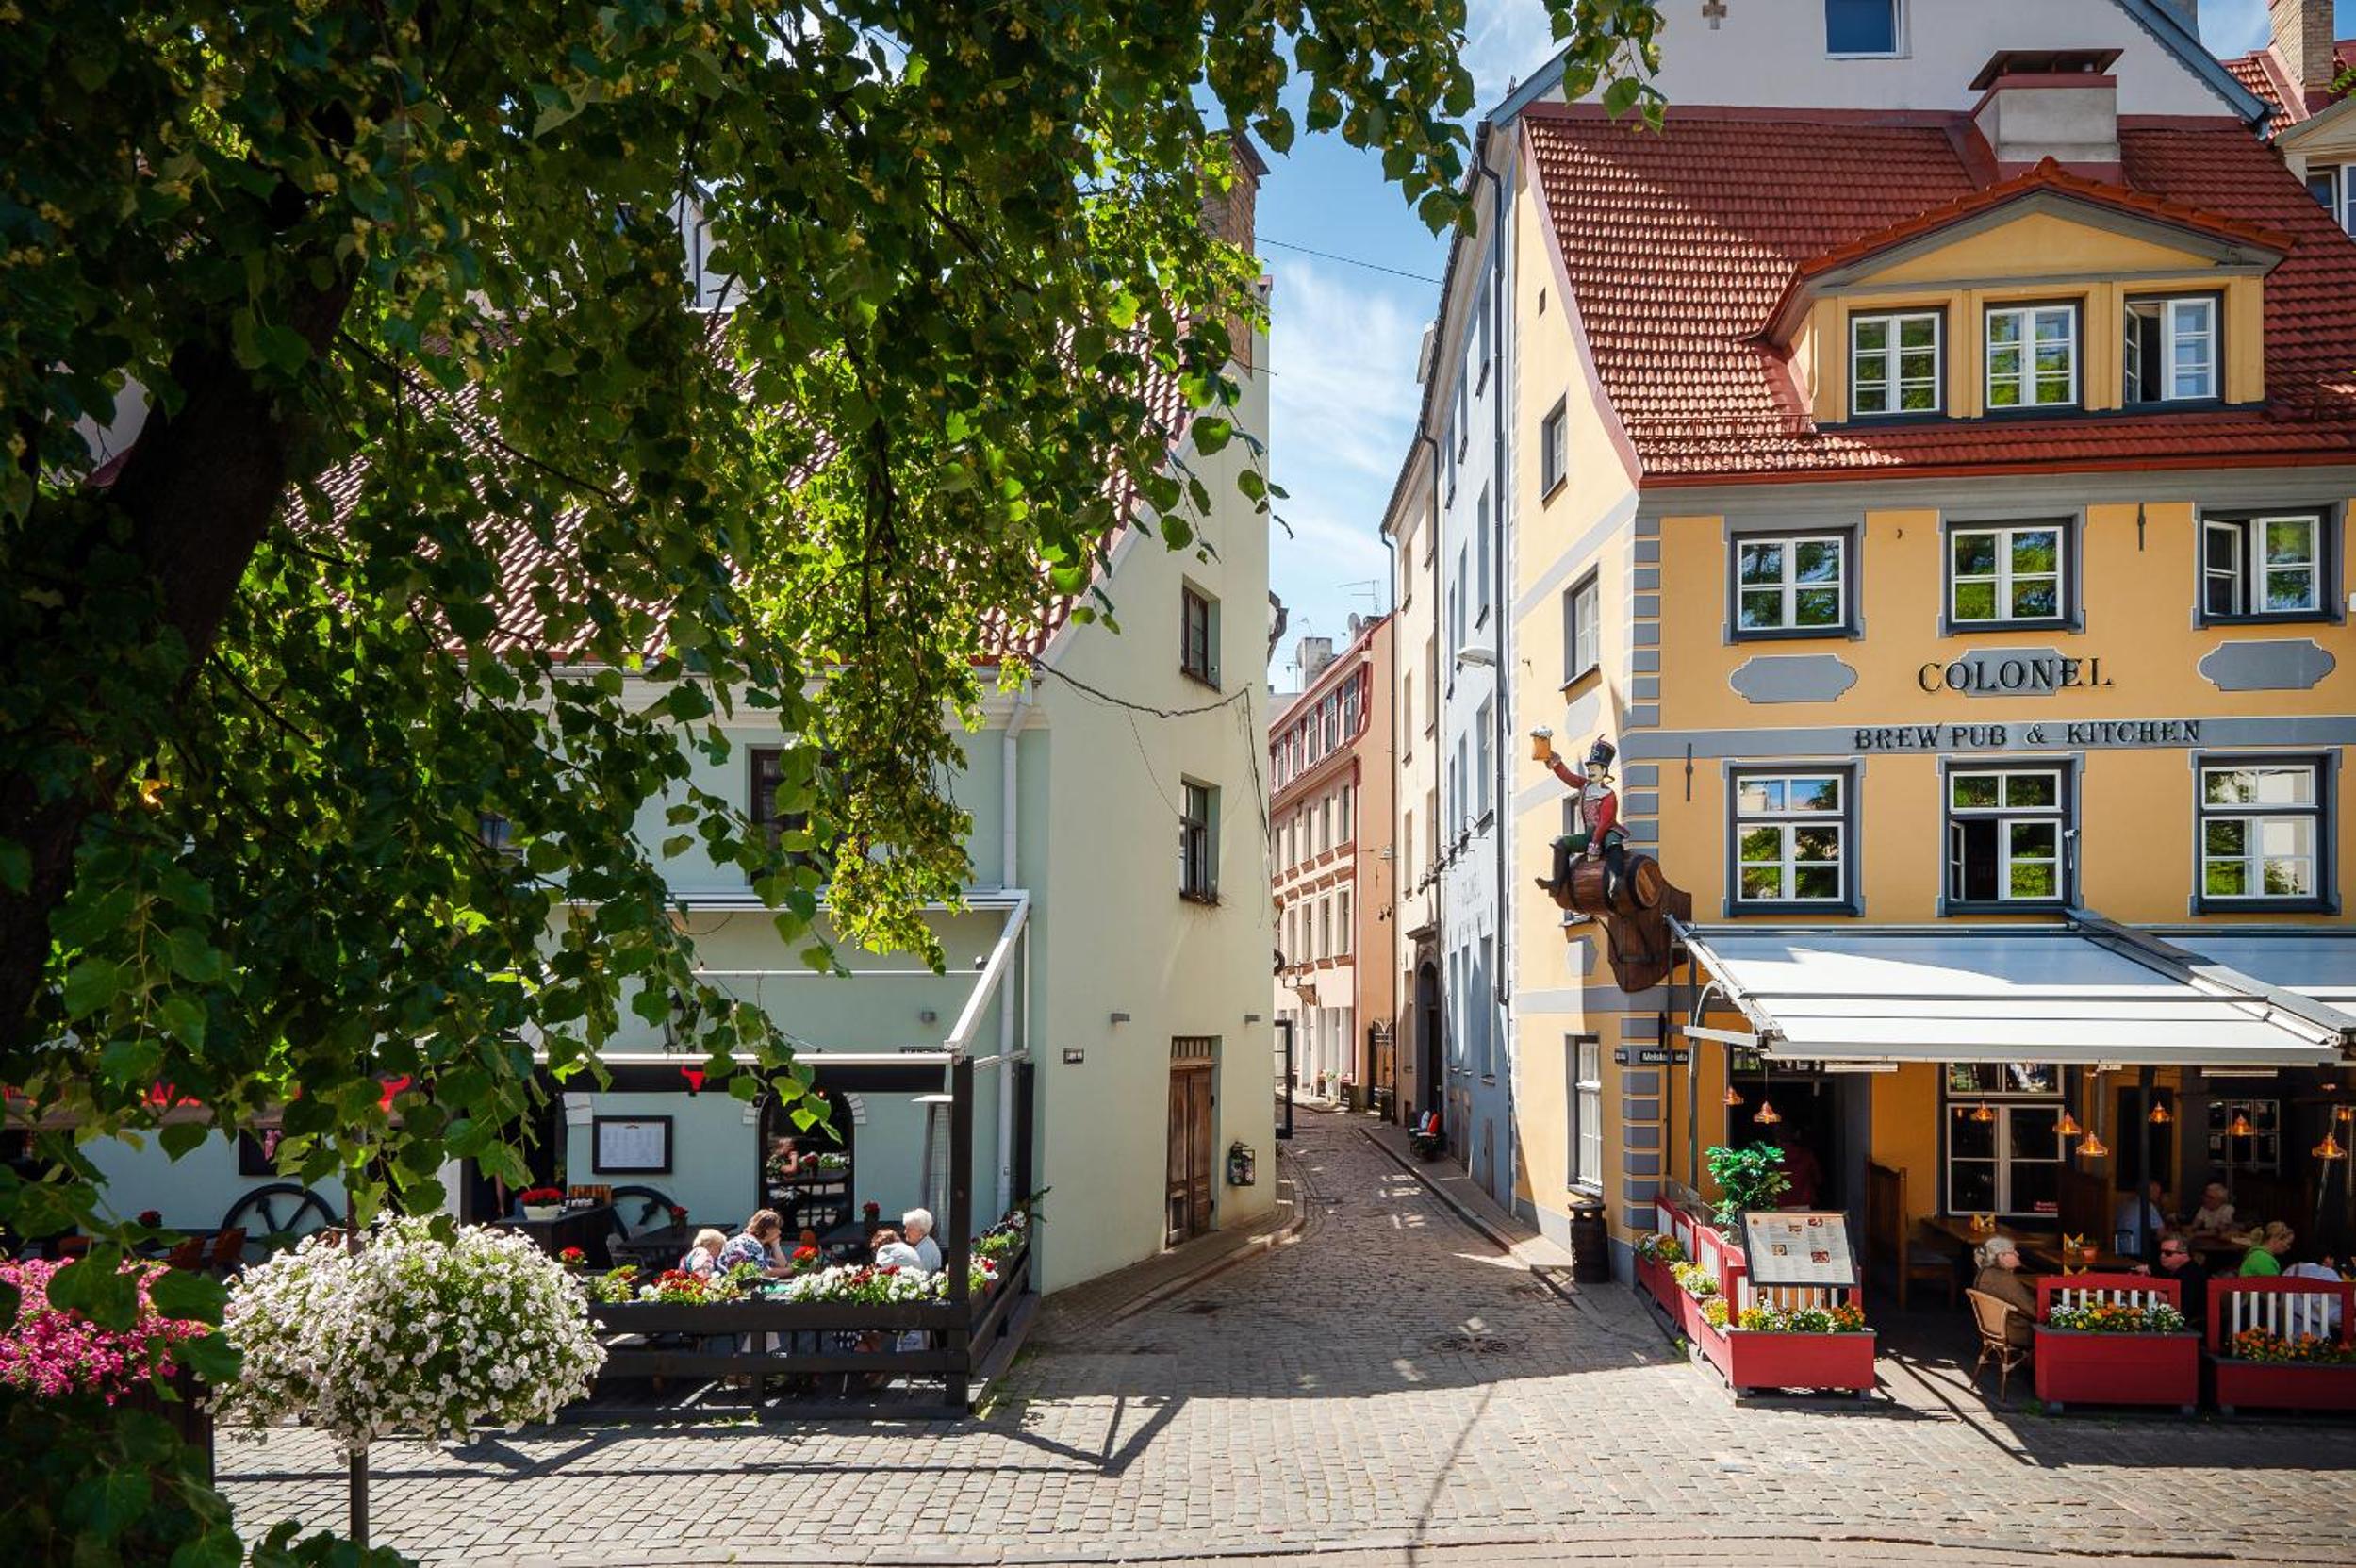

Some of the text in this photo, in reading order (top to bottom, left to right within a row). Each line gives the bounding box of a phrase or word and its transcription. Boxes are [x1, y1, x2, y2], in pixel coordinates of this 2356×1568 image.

[1918, 658, 2115, 692] COLONEL
[1854, 720, 2199, 750] BREW PUB & KITCHEN
